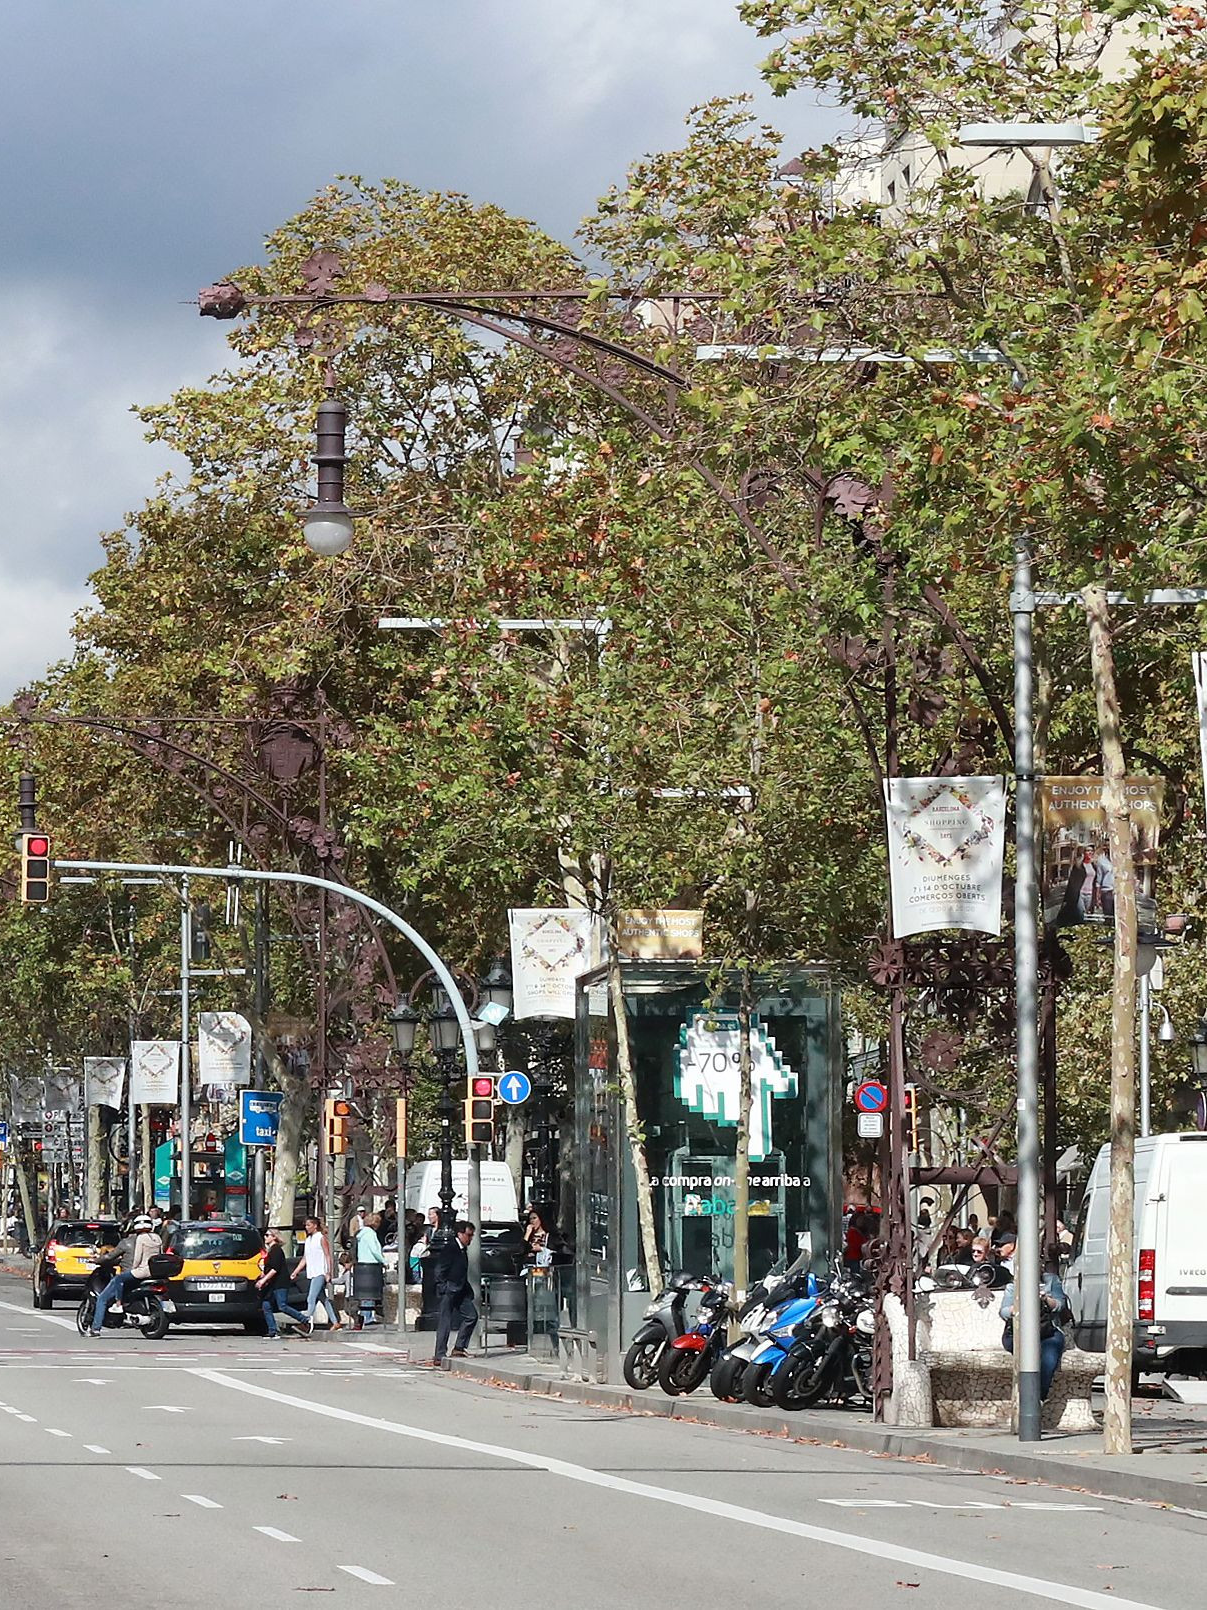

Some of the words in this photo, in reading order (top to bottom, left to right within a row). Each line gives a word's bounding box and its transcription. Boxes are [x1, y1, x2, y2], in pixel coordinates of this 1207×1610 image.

[1052, 786, 1092, 795] ENJOY
[1048, 800, 1101, 811] AUTHENT
[1129, 800, 1157, 812] HOPS
[922, 874, 971, 882] DIUMENGES
[934, 883, 981, 891] D'OCTUBRE
[955, 892, 986, 901] OBERTS
[625, 916, 653, 925] ENJOY
[673, 917, 697, 926] MOST
[622, 928, 669, 937] AUTHENTIC
[670, 930, 699, 938] SHOPS
[256, 1126, 272, 1136] taxi
[662, 1175, 711, 1190] compra
[762, 1174, 801, 1187] arriba
[803, 1176, 811, 1187] a
[1179, 1268, 1207, 1276] IVECO
